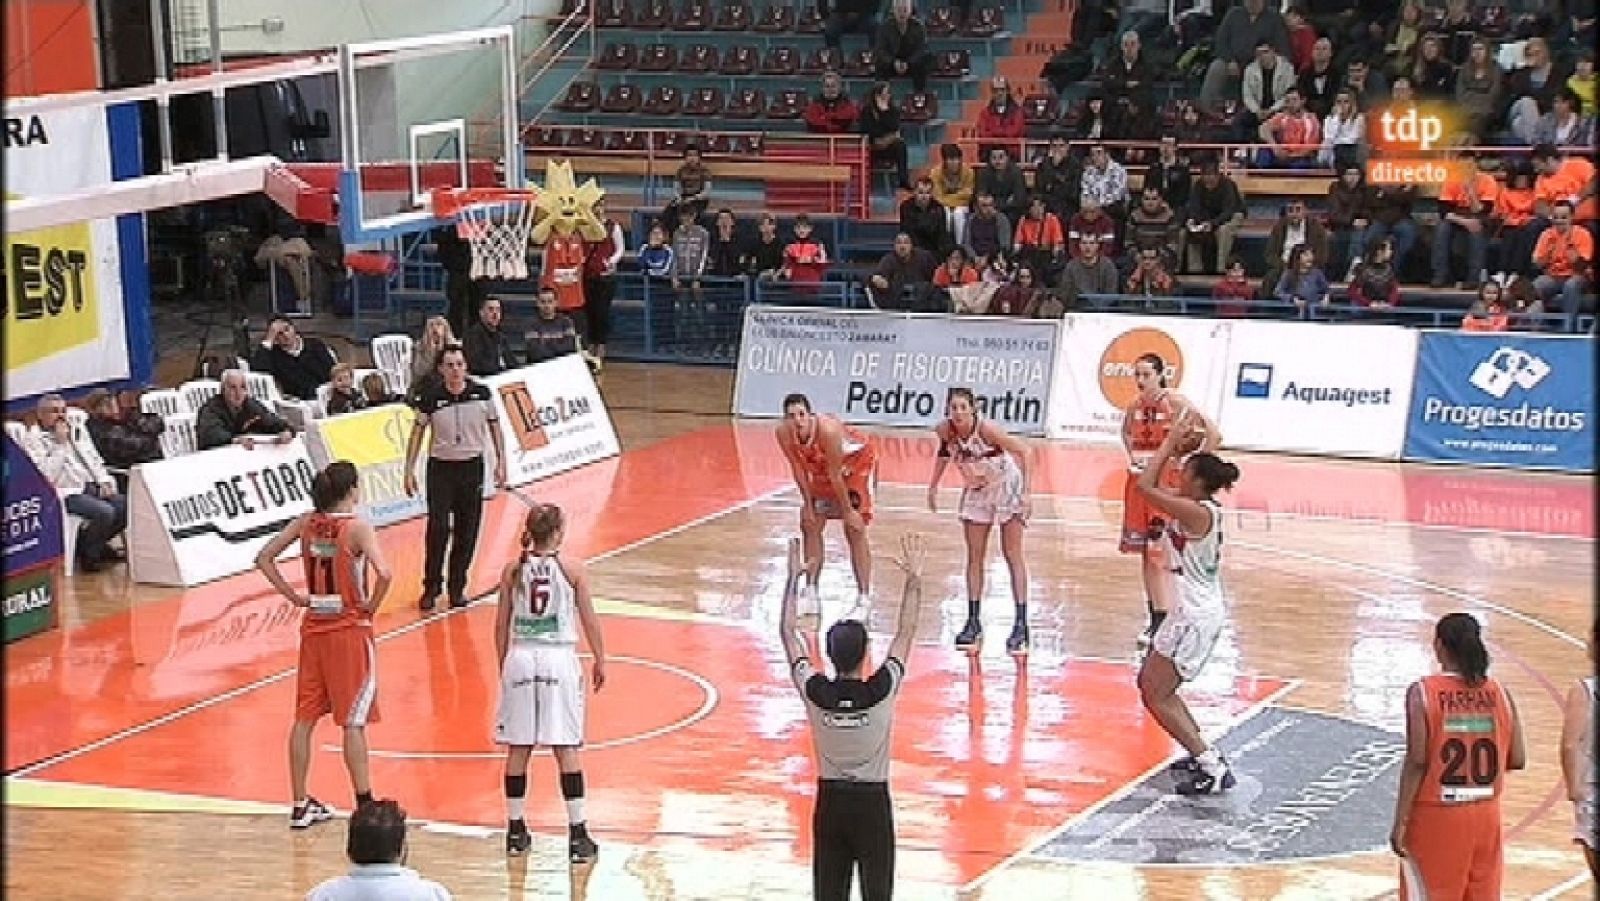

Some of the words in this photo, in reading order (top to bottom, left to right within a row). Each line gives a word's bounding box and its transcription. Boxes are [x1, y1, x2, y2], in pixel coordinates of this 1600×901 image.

[4, 242, 87, 320] EST
[748, 342, 837, 377] CLÍNICA
[851, 350, 880, 379] DE
[891, 354, 1044, 386] FISIOTERAPIA
[845, 381, 935, 417] Pedro
[945, 387, 1042, 424] artín
[1281, 381, 1393, 407] Aquagest
[1424, 397, 1586, 433] Progesdatos
[529, 578, 551, 616] 6
[1439, 738, 1498, 785] 20
